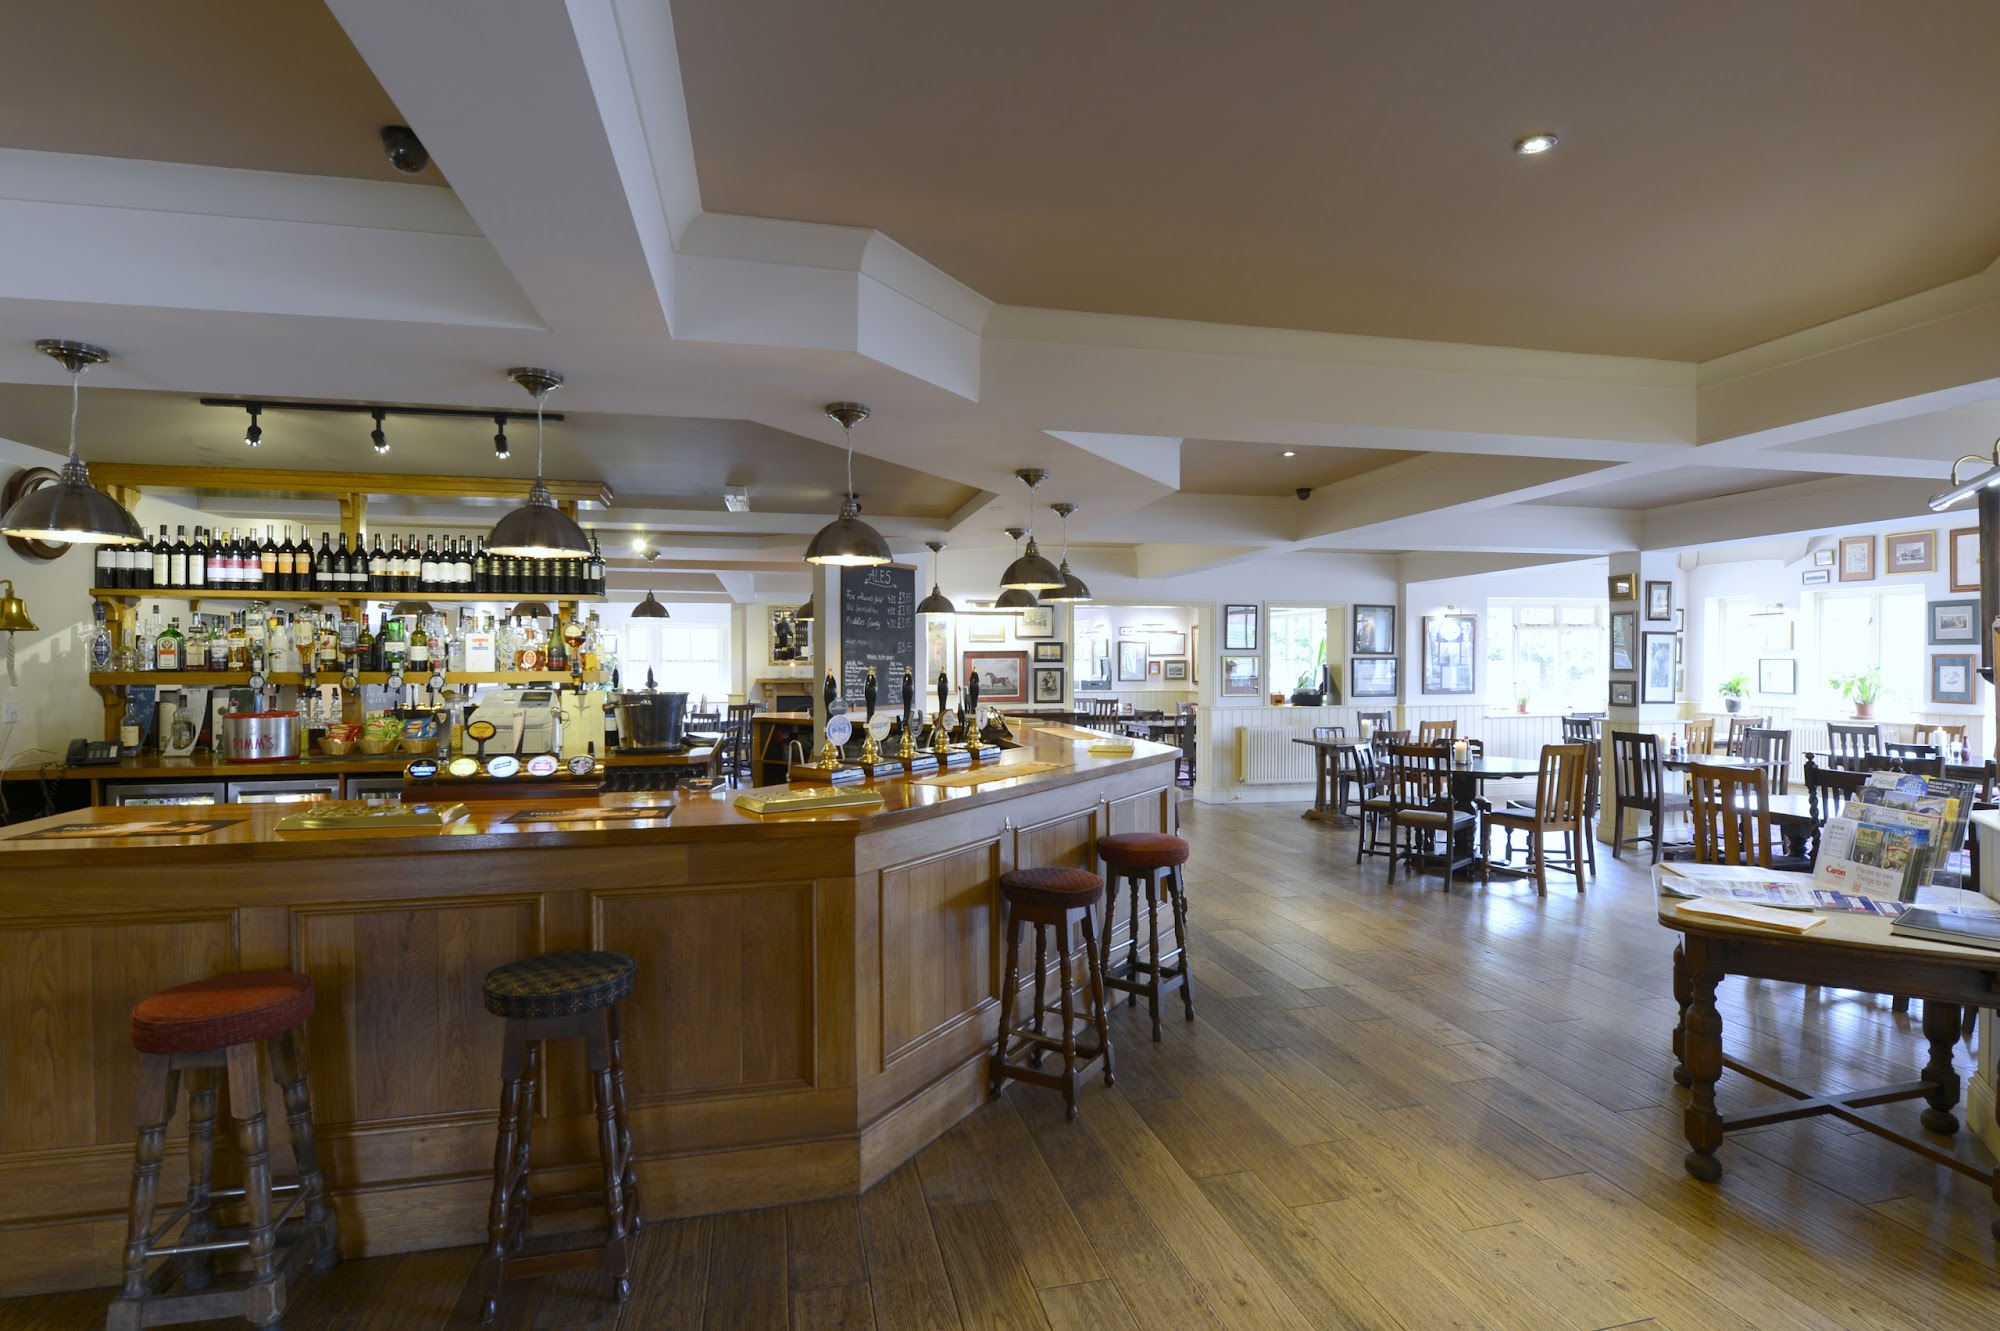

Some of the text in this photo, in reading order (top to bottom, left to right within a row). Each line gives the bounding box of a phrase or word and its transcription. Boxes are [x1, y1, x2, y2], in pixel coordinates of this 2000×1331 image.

[865, 568, 891, 585] ALES
[233, 735, 274, 750] PIMM'S
[1826, 866, 1846, 876] Caron
[1855, 866, 1875, 876] Places
[1857, 874, 1874, 884] Things
